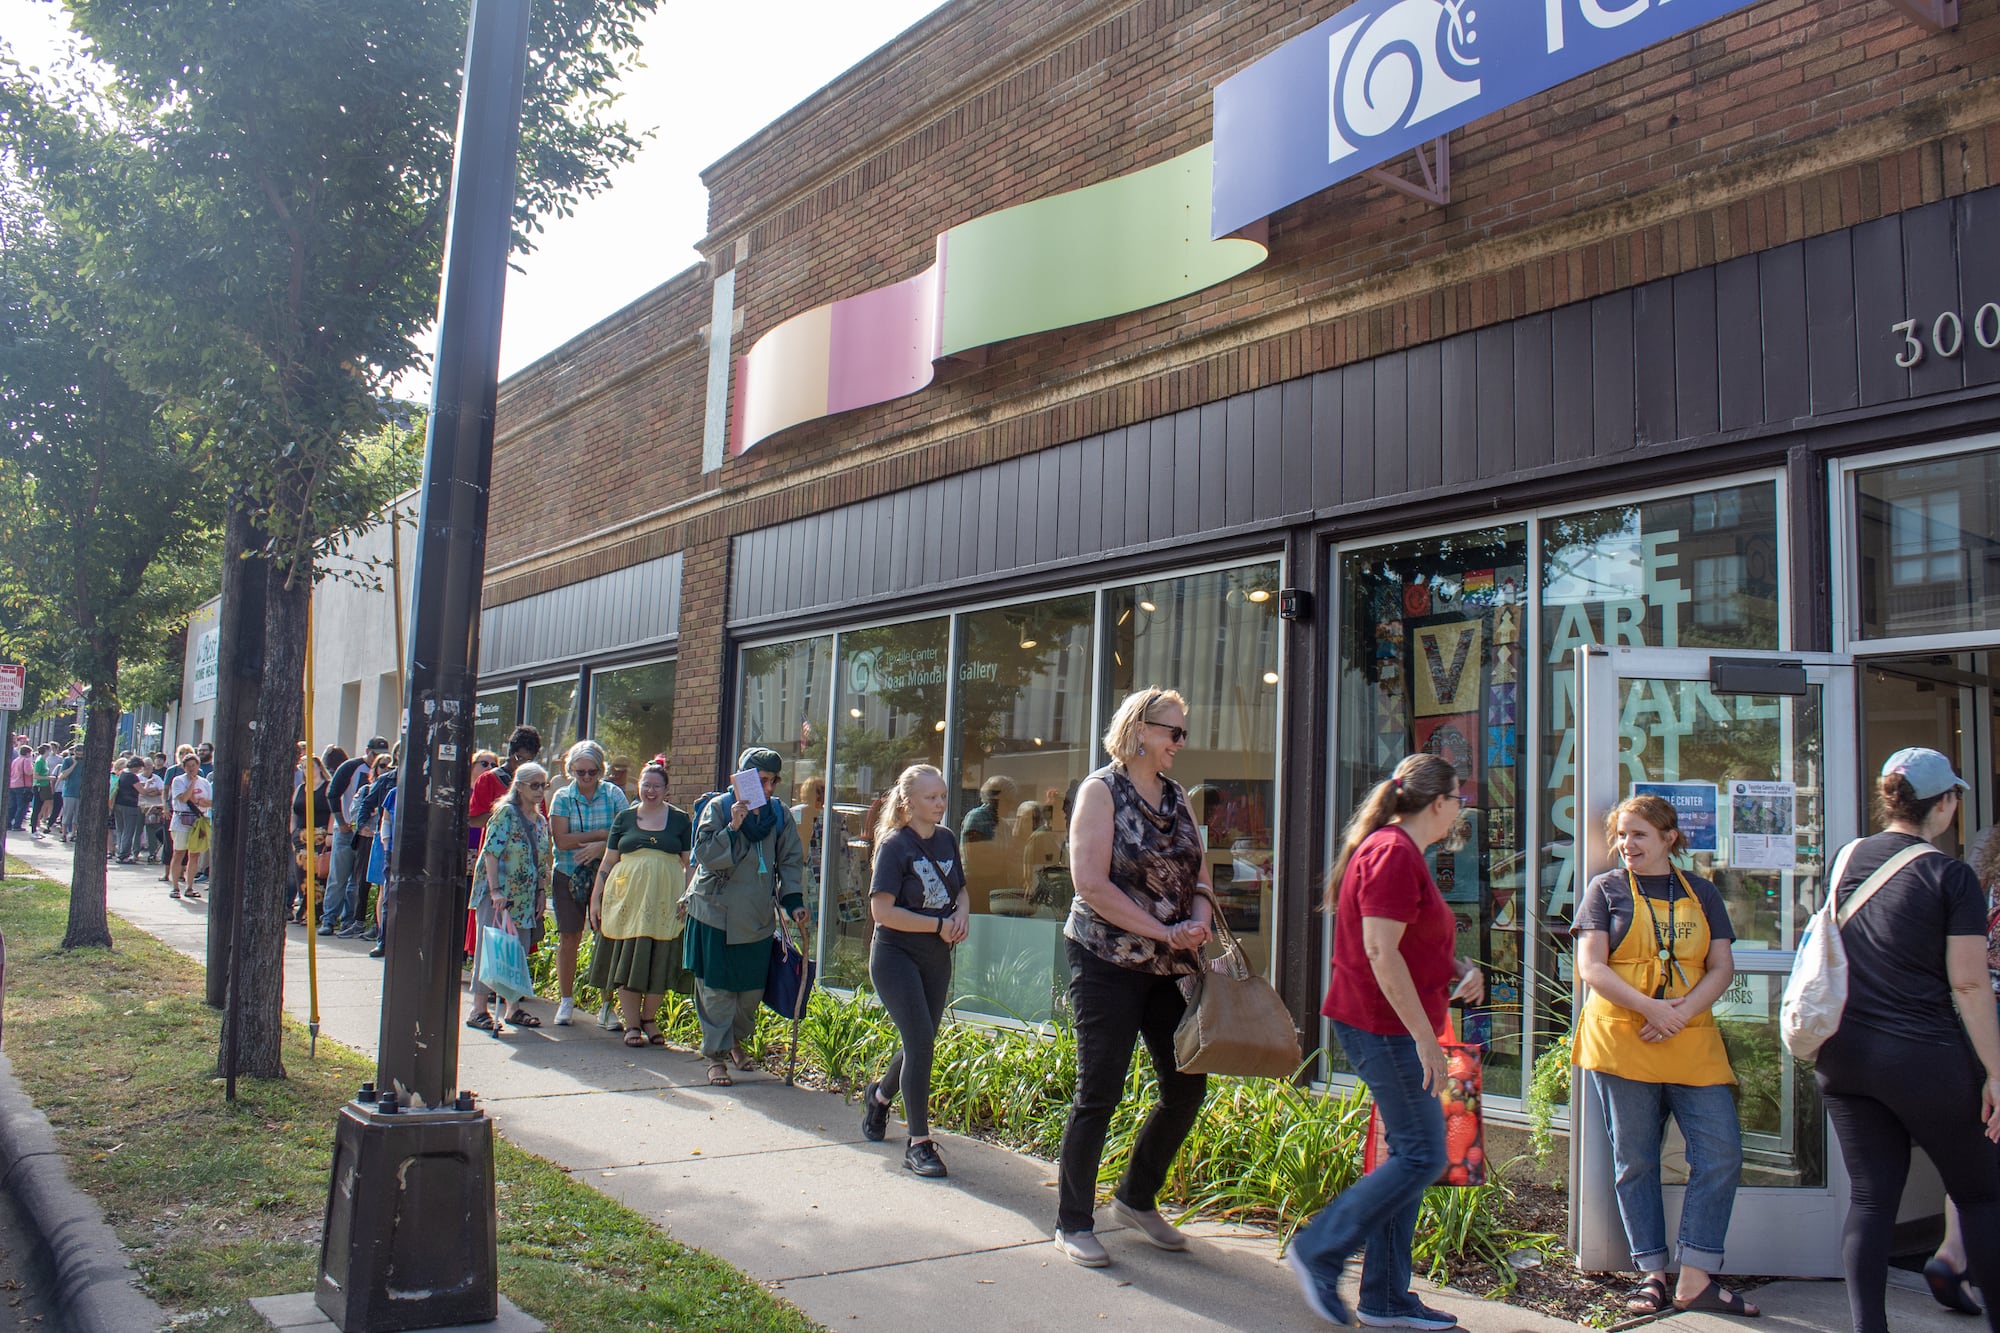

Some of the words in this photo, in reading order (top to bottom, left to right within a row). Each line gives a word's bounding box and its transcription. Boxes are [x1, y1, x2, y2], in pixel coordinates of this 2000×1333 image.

[911, 648, 938, 661] Center
[959, 660, 998, 682] Gallery
[1677, 796, 1703, 806] CENTER
[1656, 927, 1692, 939] TFF
[494, 935, 524, 970] KNI
[1722, 989, 1753, 1004] MISES
